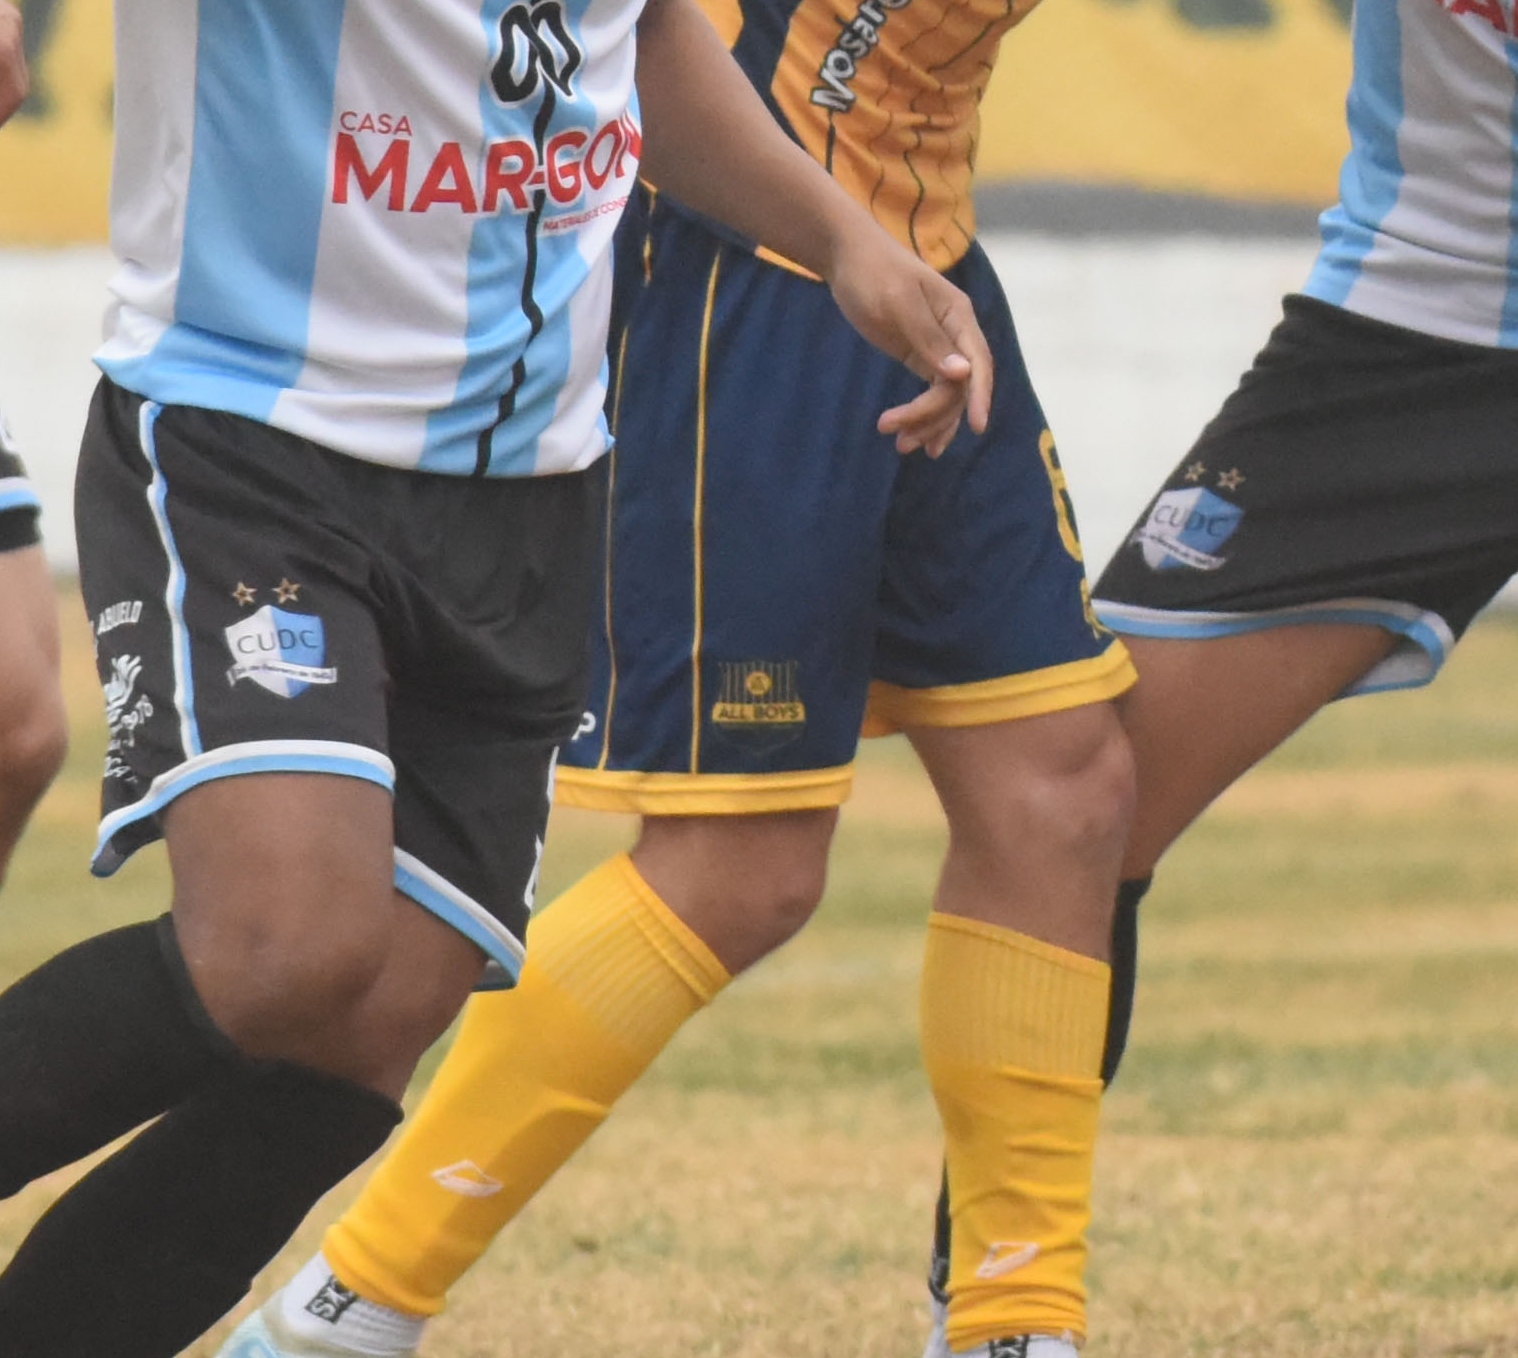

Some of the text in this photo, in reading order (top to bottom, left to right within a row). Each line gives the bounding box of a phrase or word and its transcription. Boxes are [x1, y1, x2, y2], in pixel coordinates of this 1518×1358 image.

[339, 110, 414, 137] CASA
[236, 628, 320, 654] CUDC
[718, 704, 800, 721] ALL BOYS
